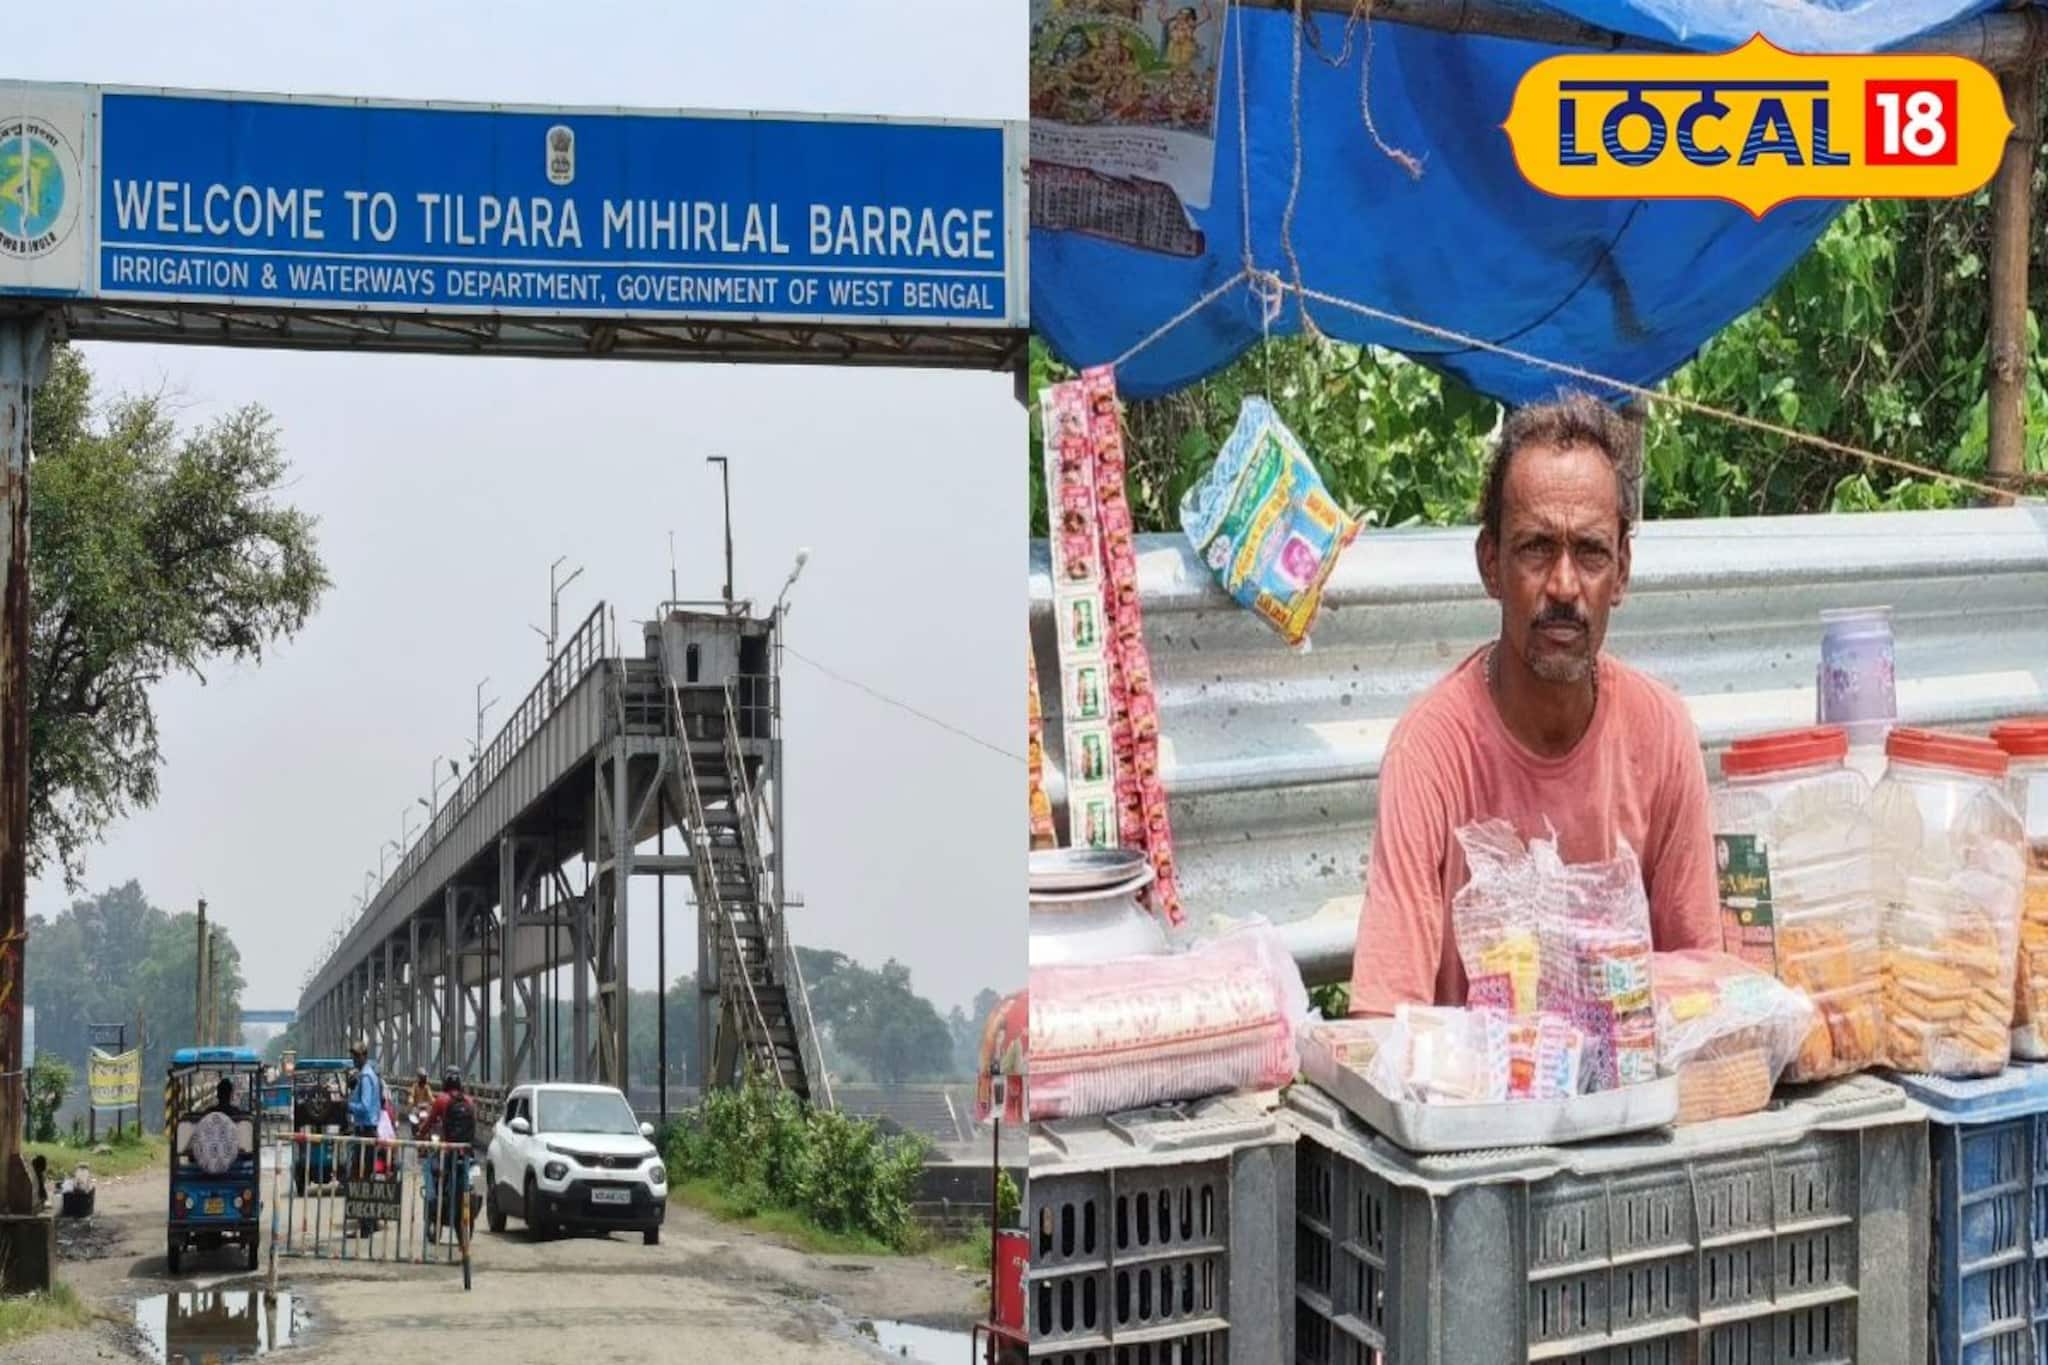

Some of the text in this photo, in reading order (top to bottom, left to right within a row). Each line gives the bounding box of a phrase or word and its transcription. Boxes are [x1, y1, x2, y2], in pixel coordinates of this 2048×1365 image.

[114, 179, 324, 239] WELCOME
[345, 191, 397, 242] TO
[417, 194, 582, 248] TILPARA
[603, 200, 789, 253] MIHIRLAL
[810, 204, 995, 259] BARRAGE
[112, 256, 994, 310] IRRIGATION & WATERWAYS DEPARTMENT, GOVERNMENT OF WEST BENGAL
